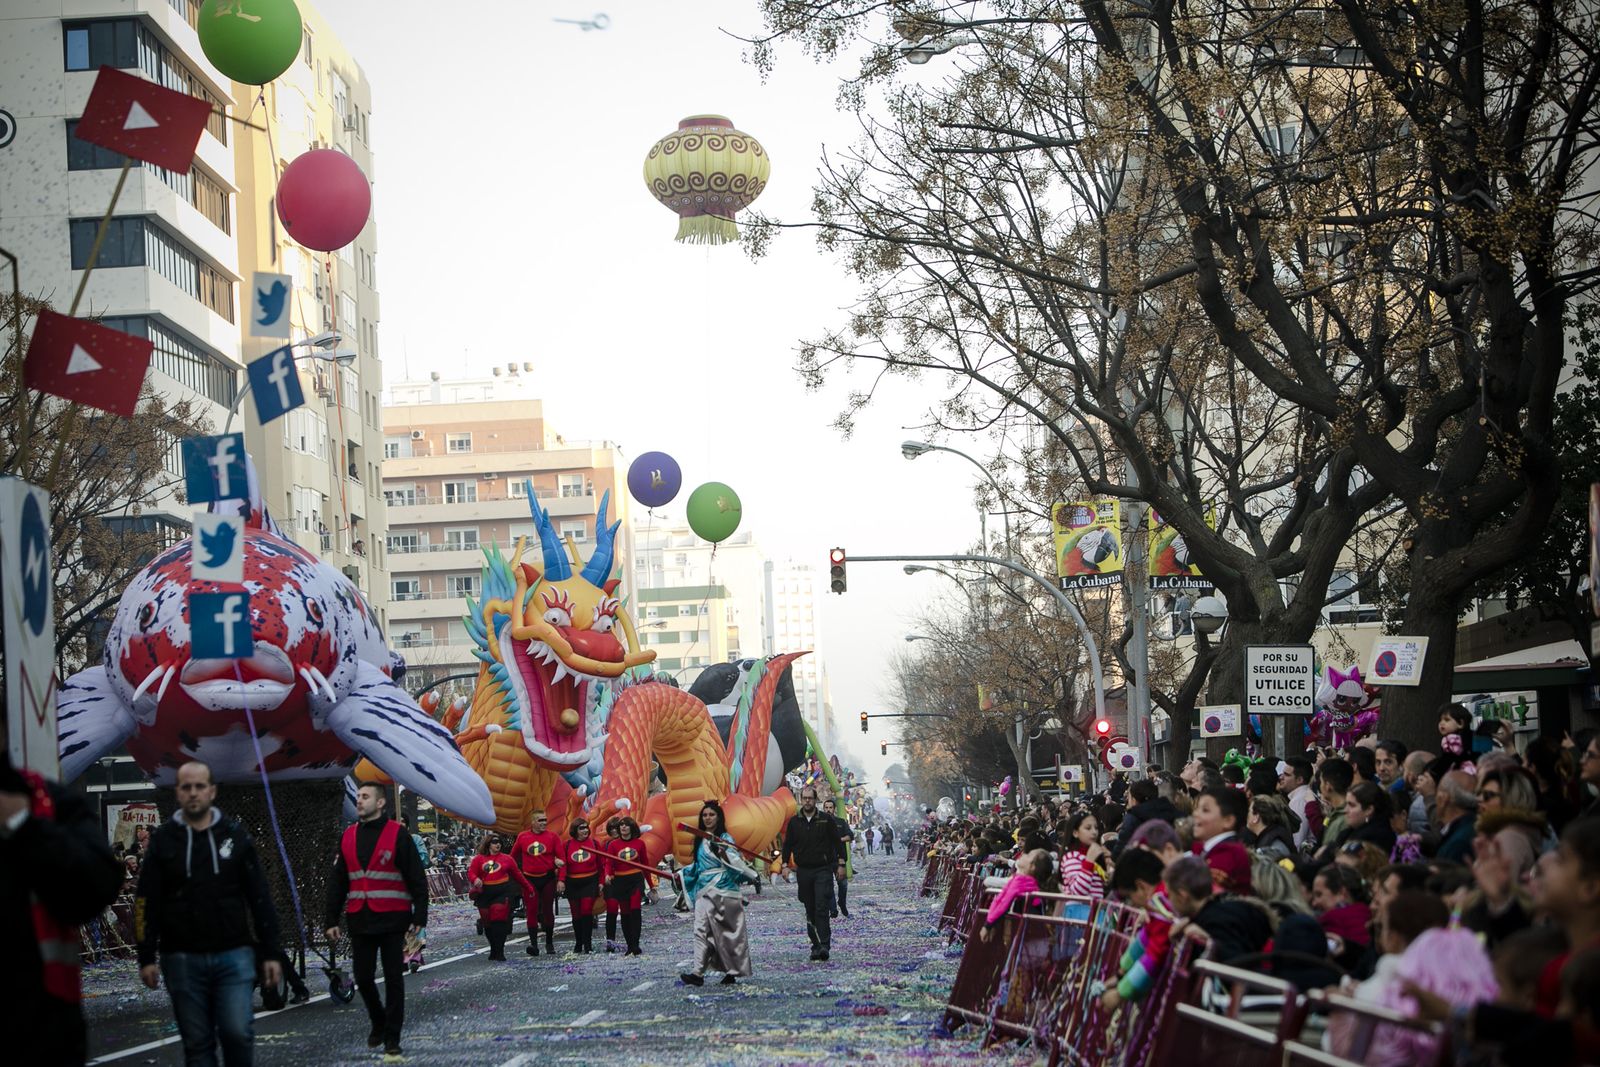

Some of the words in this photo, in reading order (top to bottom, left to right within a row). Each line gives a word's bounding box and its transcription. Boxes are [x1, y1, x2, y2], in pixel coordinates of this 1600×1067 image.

[1061, 577, 1077, 589] La
[1078, 574, 1121, 588] Cubana
[1152, 577, 1167, 588] La
[1263, 653, 1283, 662] POR
[1285, 653, 1298, 662] SU
[1252, 665, 1308, 674] SEGURIDAD
[1255, 679, 1305, 690] UTILICE
[1249, 695, 1264, 706] EL
[1268, 695, 1311, 706] CASCO
[123, 811, 156, 824] RA-TA-TA
